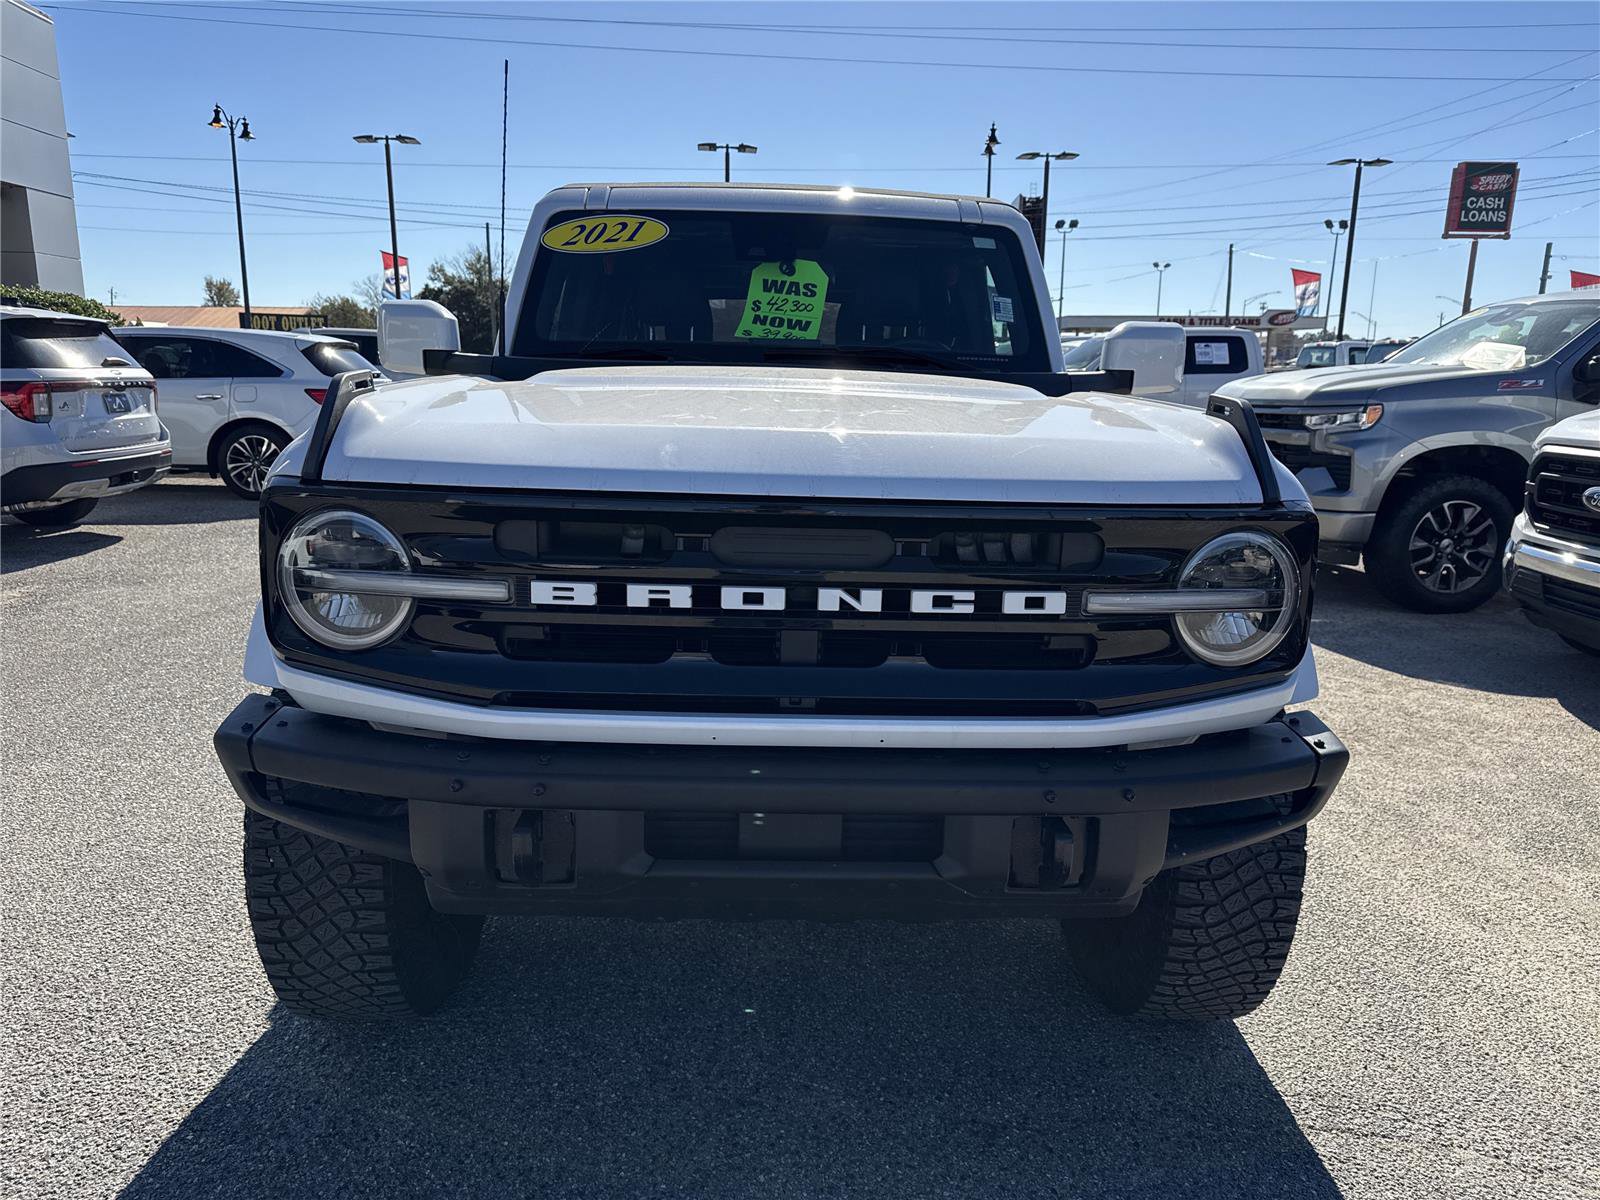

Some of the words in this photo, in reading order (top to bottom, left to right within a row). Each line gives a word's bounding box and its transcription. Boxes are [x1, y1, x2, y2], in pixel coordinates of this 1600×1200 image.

[1479, 174, 1512, 185] SPEEDY
[1479, 183, 1507, 191] CASH
[1467, 197, 1505, 209] CASH
[1460, 210, 1507, 222] LOANS
[561, 221, 648, 247] 2021
[762, 278, 818, 297] WAS
[751, 299, 762, 313] $
[766, 296, 814, 315] 42,300
[250, 315, 277, 330] OOT
[751, 314, 813, 332] NOW
[1198, 318, 1225, 326] TITLE
[1228, 318, 1261, 326] LOANS
[530, 579, 1067, 614] BRONCO
